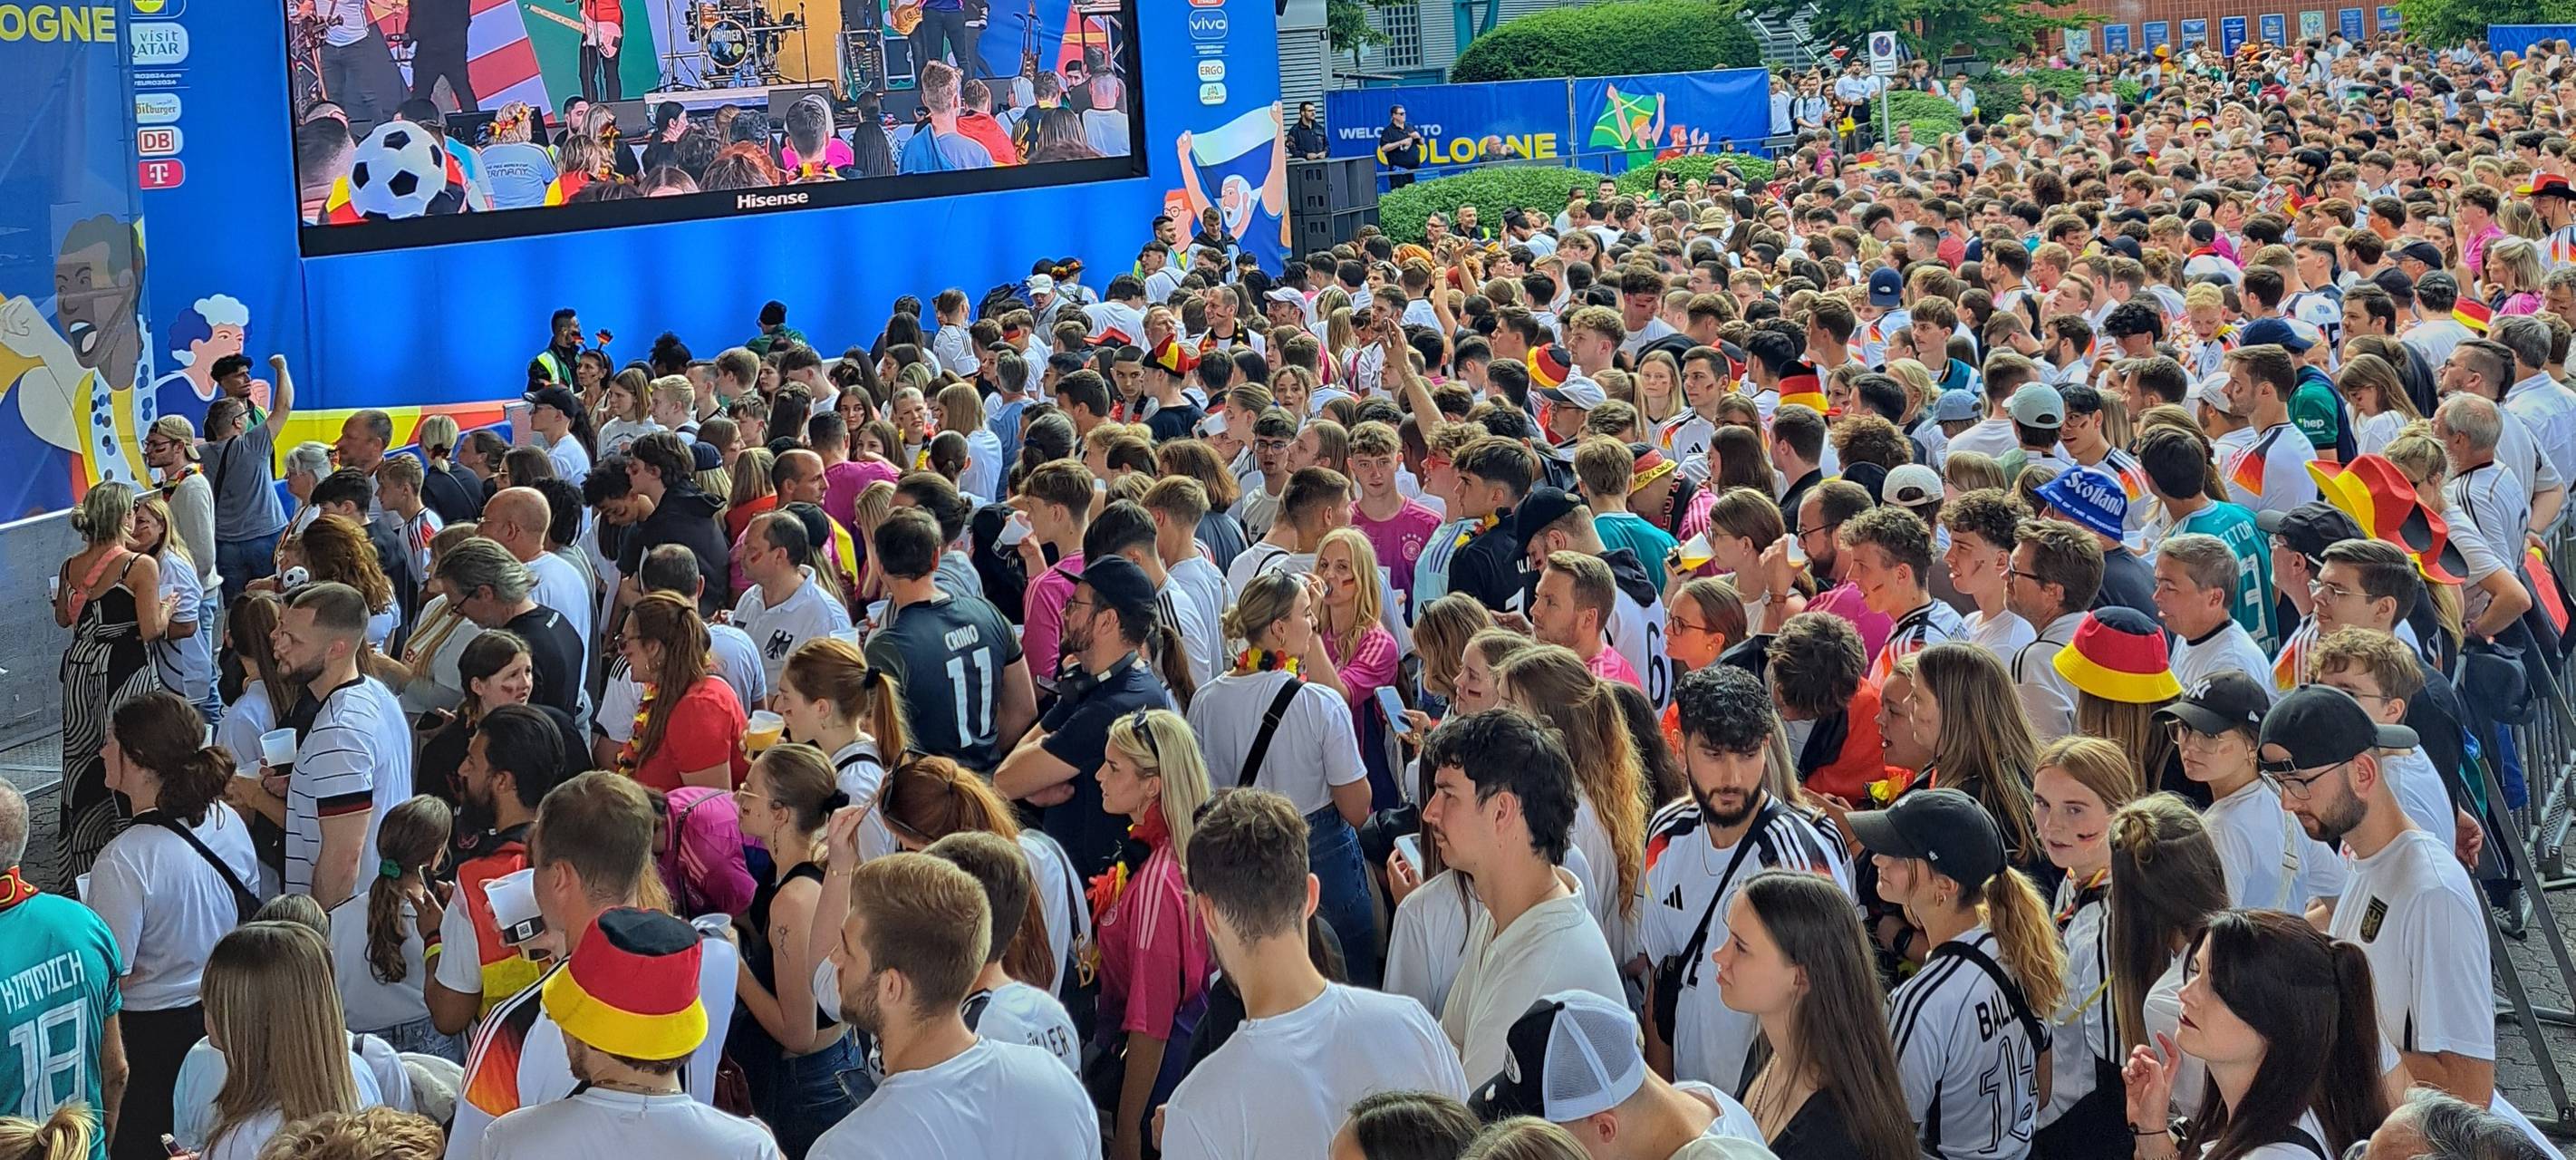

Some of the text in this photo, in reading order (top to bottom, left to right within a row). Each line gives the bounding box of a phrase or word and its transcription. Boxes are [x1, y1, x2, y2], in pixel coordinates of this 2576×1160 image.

[0, 4, 116, 43] OGNE
[140, 29, 178, 42] visit
[1191, 16, 1227, 30] vivo
[1200, 65, 1223, 75] ERGO
[142, 133, 170, 150] DB
[1419, 123, 1442, 136] TO
[149, 162, 169, 185] T
[737, 192, 809, 209] Hisense
[2302, 418, 2325, 430] hep
[2064, 470, 2125, 517] Scotland
[1646, 621, 1666, 711] 6
[945, 645, 993, 749] 11
[0, 949, 85, 1016] KIMMICH
[1974, 989, 2018, 1043] BALL
[8, 996, 88, 1126] 18
[1978, 1035, 2039, 1155] 13
